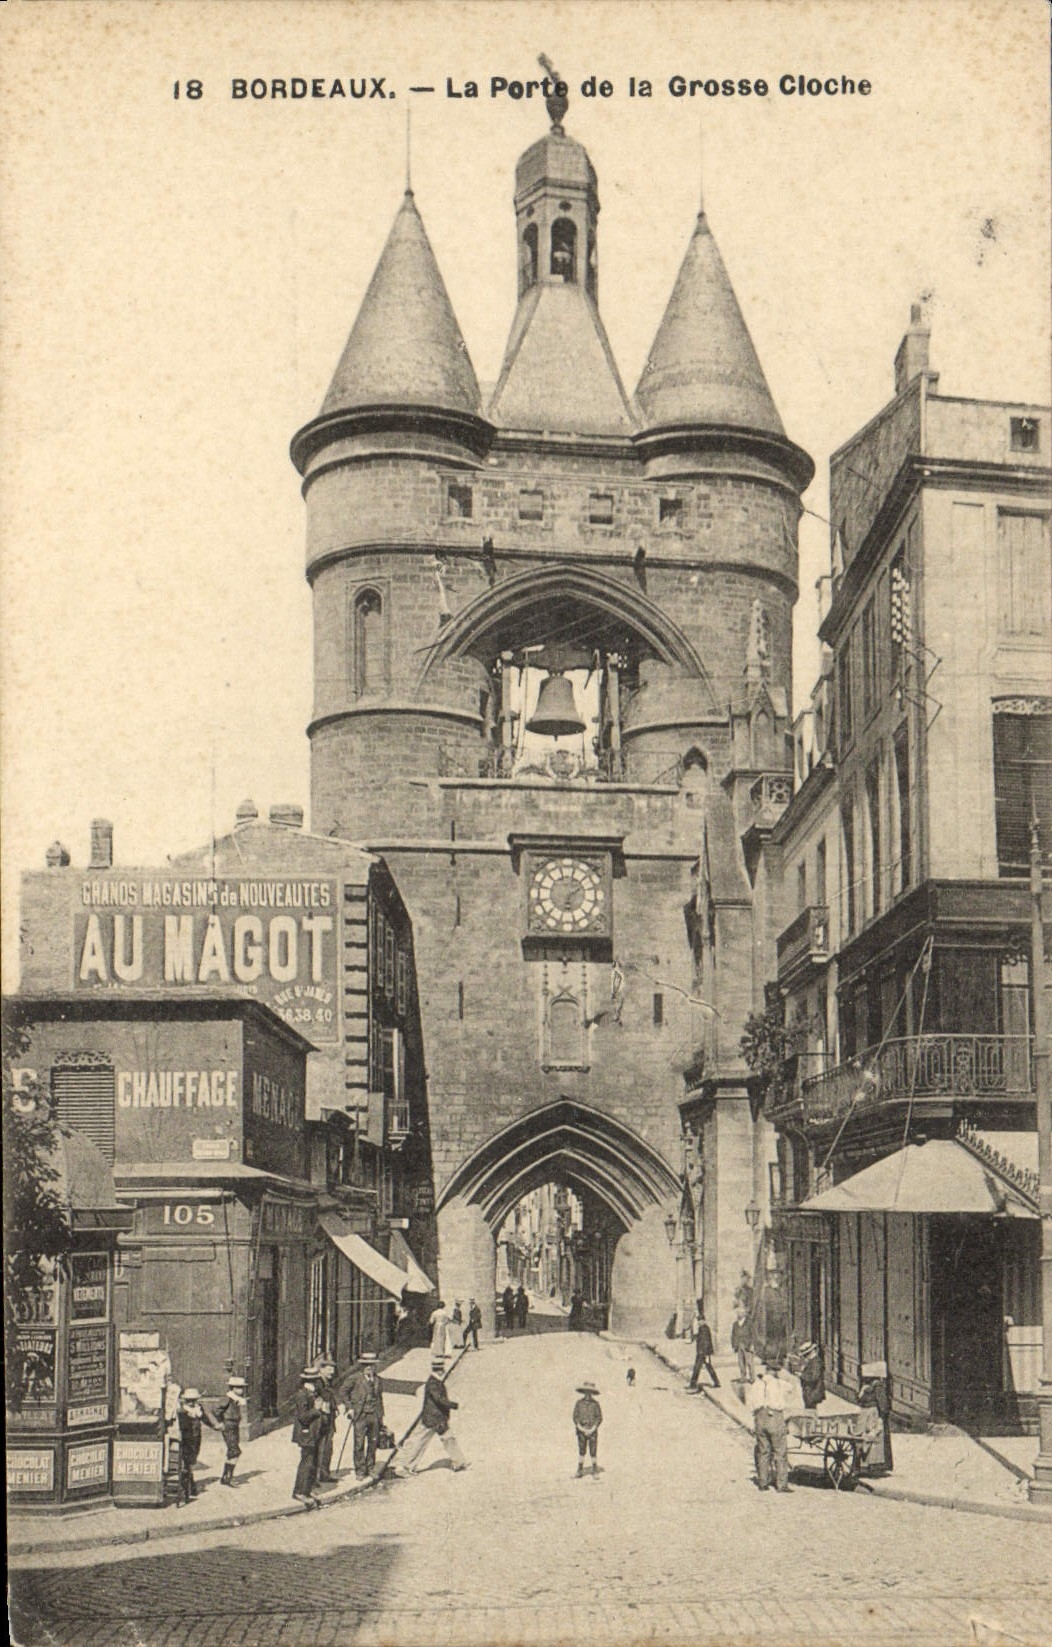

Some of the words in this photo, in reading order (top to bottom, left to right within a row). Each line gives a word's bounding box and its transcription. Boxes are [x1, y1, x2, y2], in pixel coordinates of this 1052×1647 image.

[82, 882, 137, 905] GRANDS
[142, 881, 218, 906] MAGASINS
[220, 884, 237, 906] de
[79, 914, 143, 981] AU
[164, 914, 333, 982] MAGOT
[117, 1071, 238, 1108] CHAUFFAGE
[163, 1205, 215, 1225] 105
